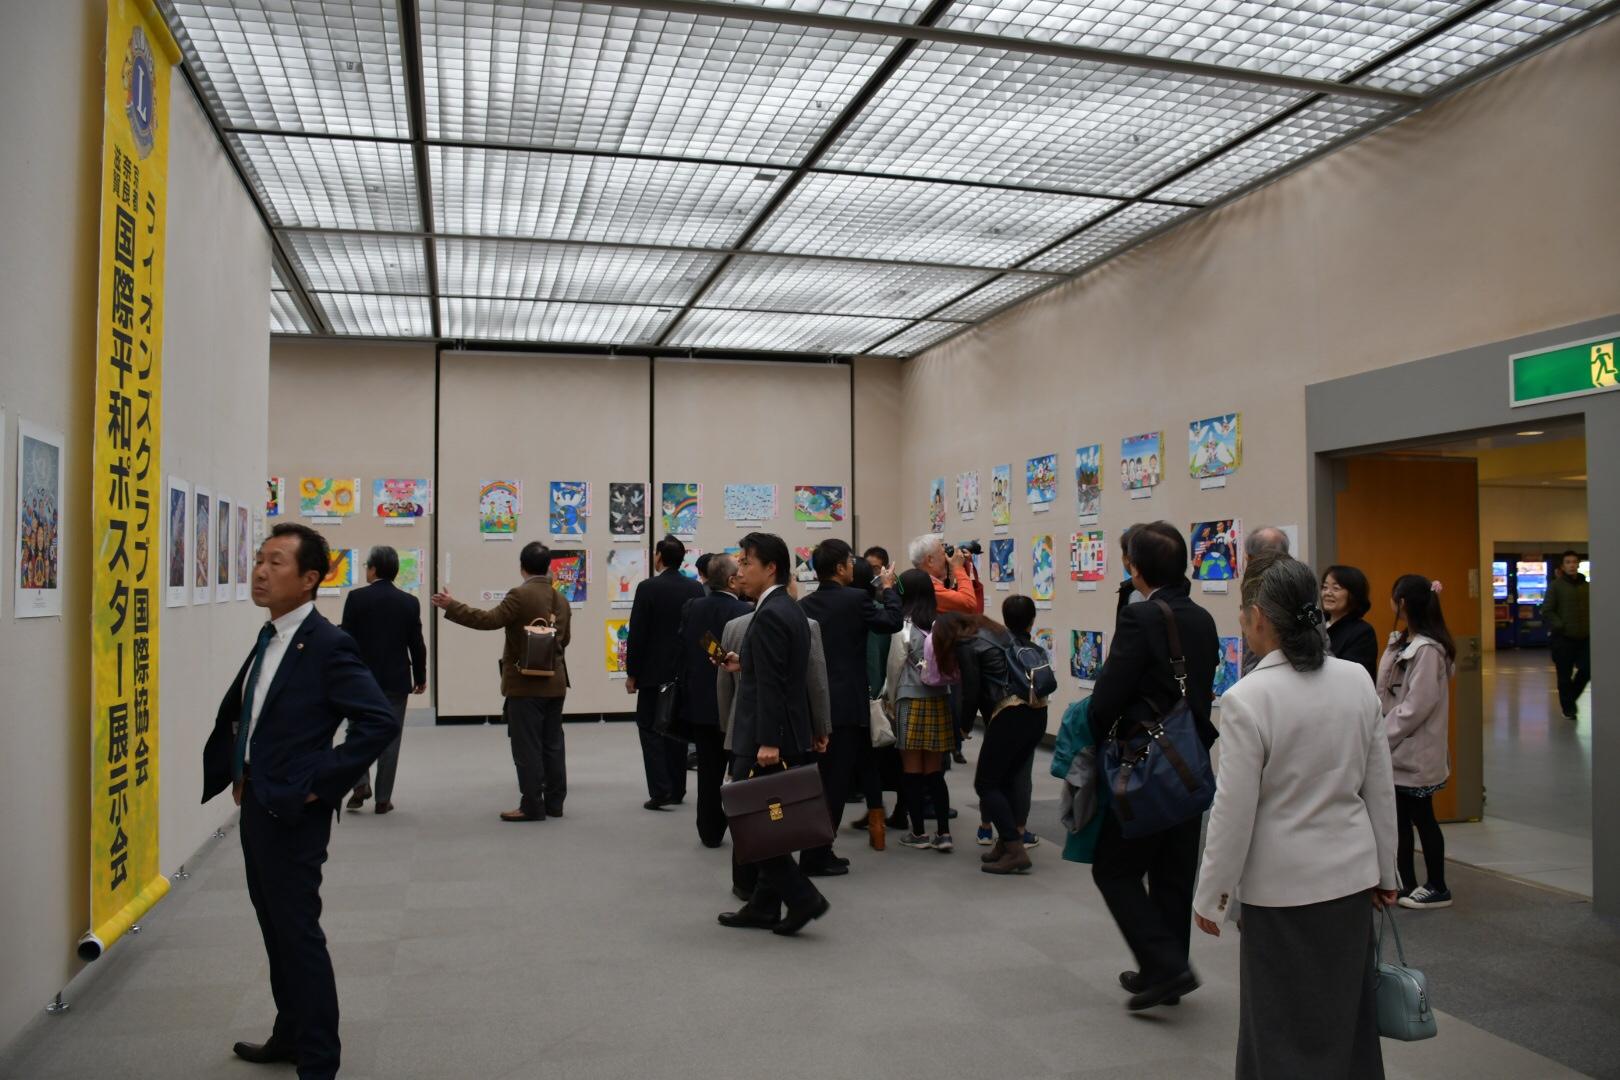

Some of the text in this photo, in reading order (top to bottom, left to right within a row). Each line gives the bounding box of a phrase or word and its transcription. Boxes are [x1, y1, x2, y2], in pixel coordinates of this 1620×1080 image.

[108, 203, 136, 891] 国際平和ポスター展示会
[134, 189, 155, 787] ライオンズクラブ国際協会
